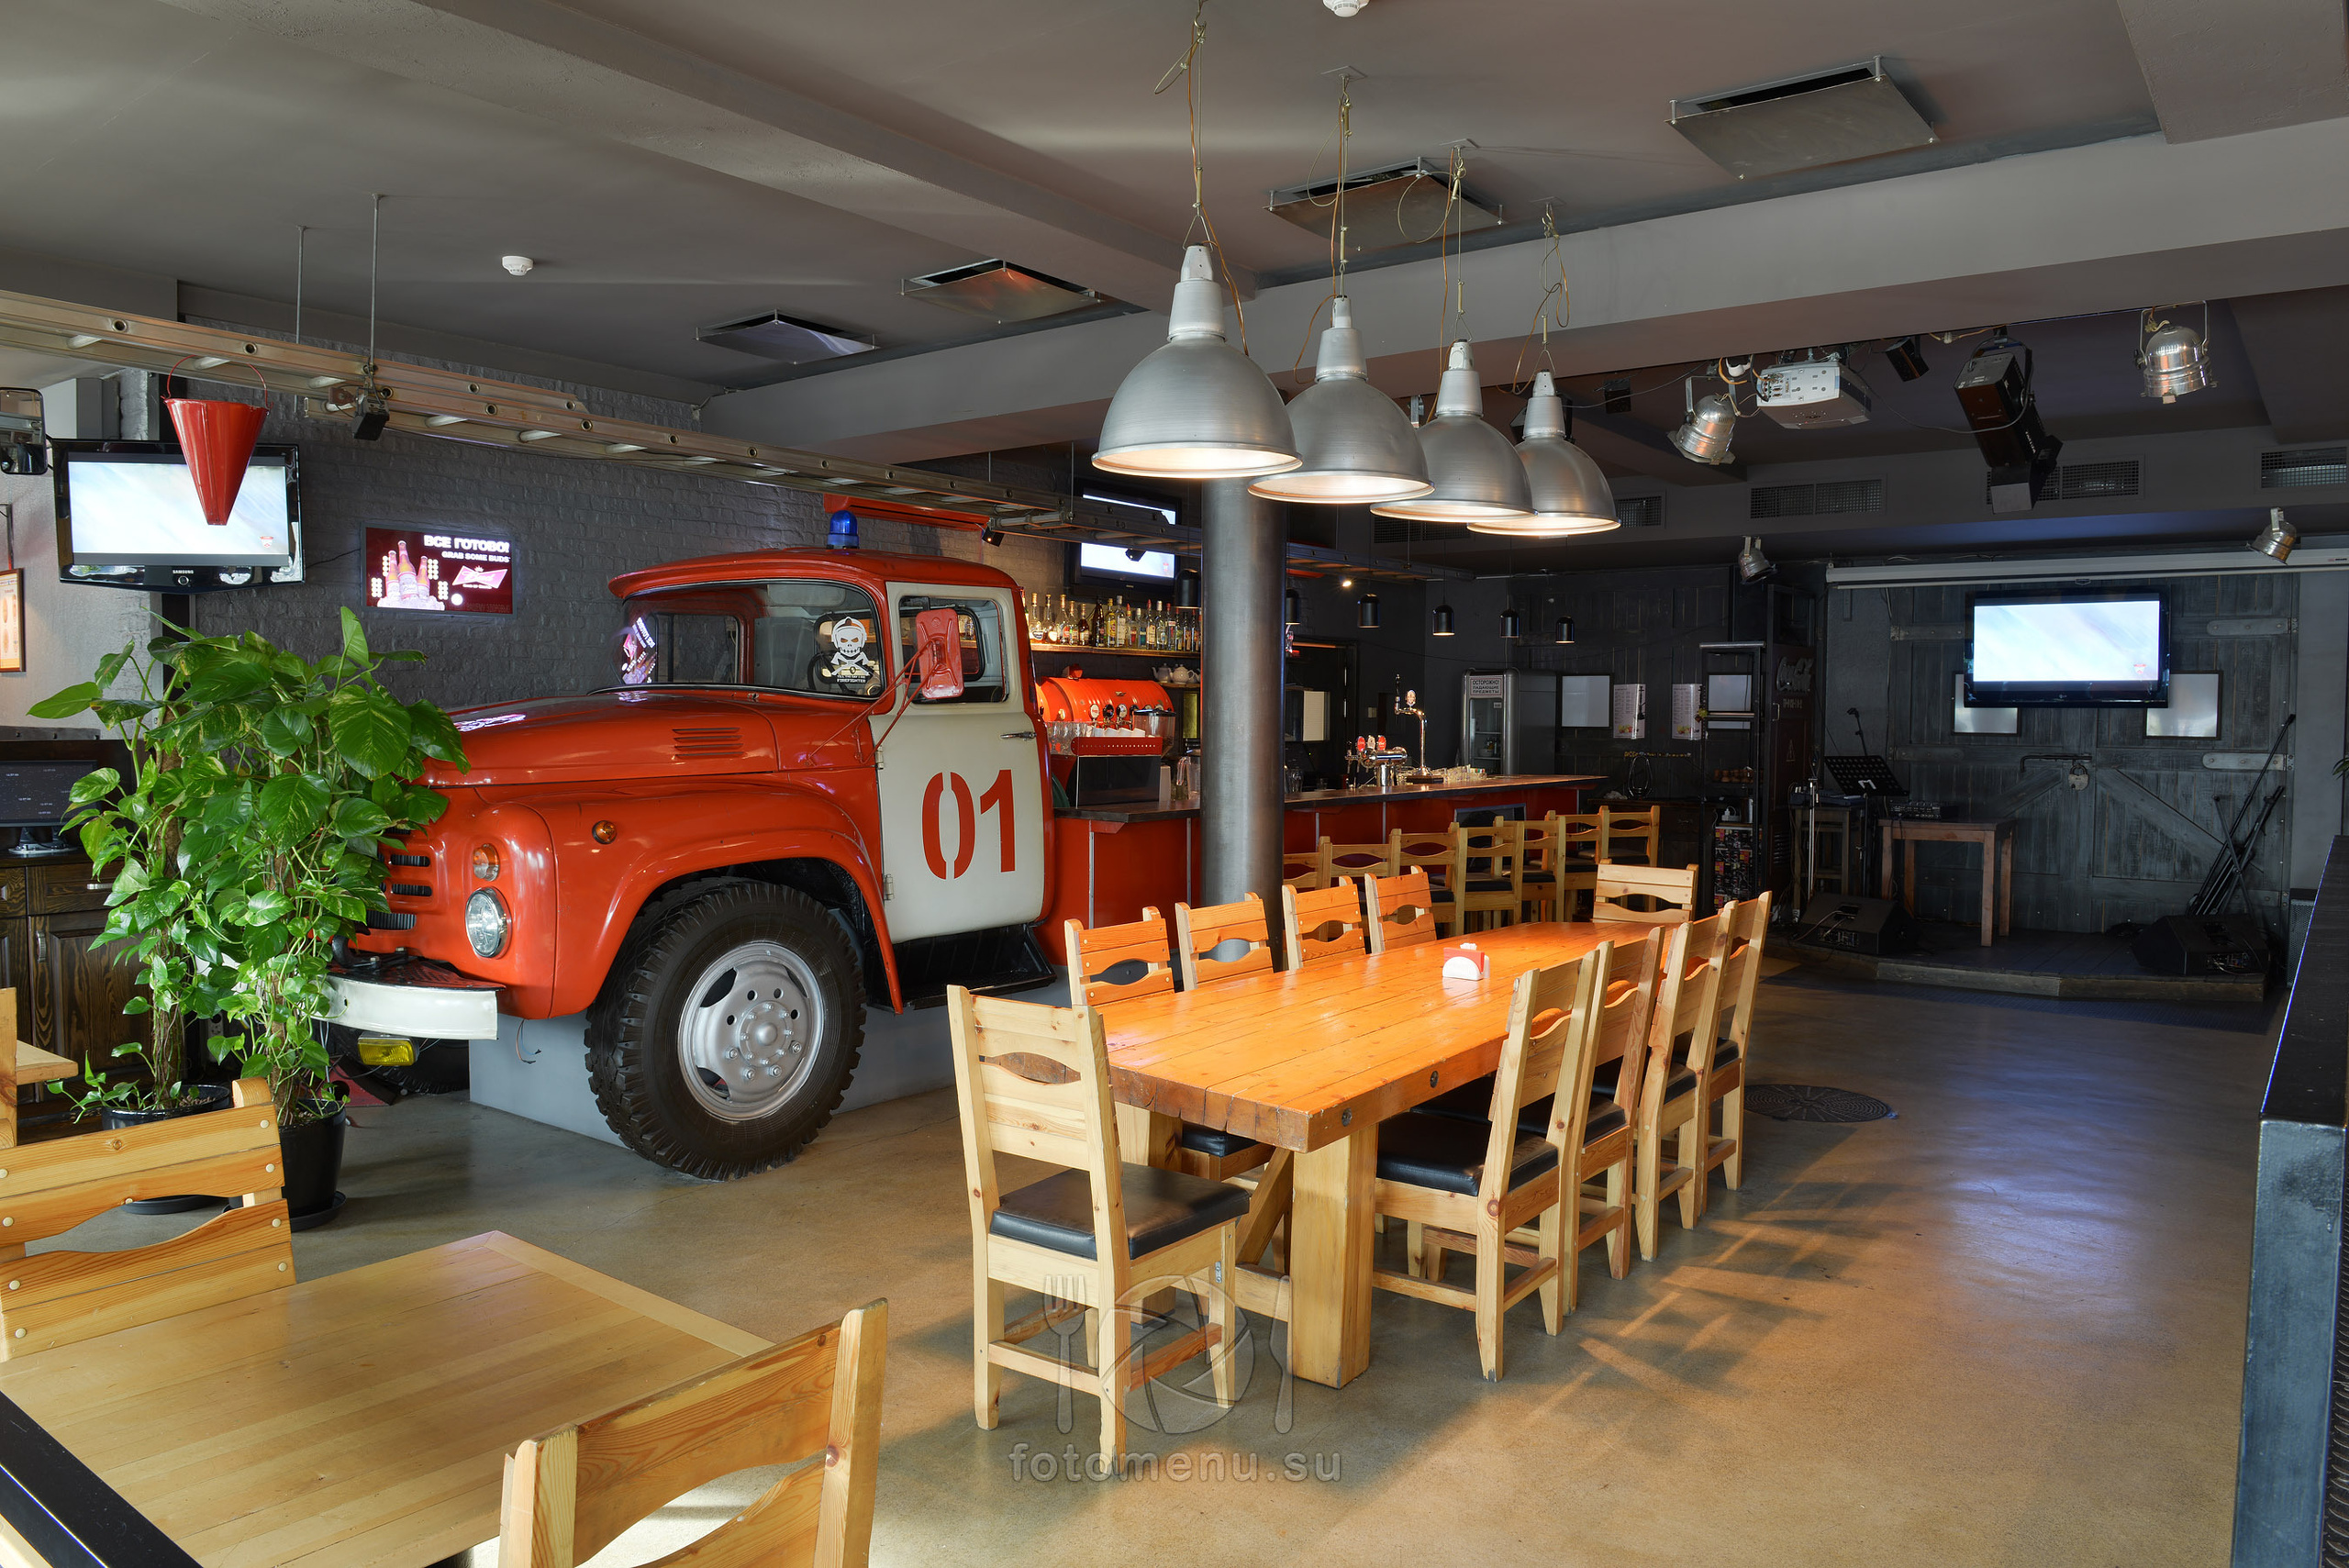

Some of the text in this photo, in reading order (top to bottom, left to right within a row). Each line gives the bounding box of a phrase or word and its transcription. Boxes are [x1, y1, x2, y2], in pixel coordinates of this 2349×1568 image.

[424, 535, 510, 553] ВСЕ ГОТОВО!
[441, 550, 464, 559] GRAB
[464, 552, 487, 562] SOME
[922, 769, 1015, 880] 01
